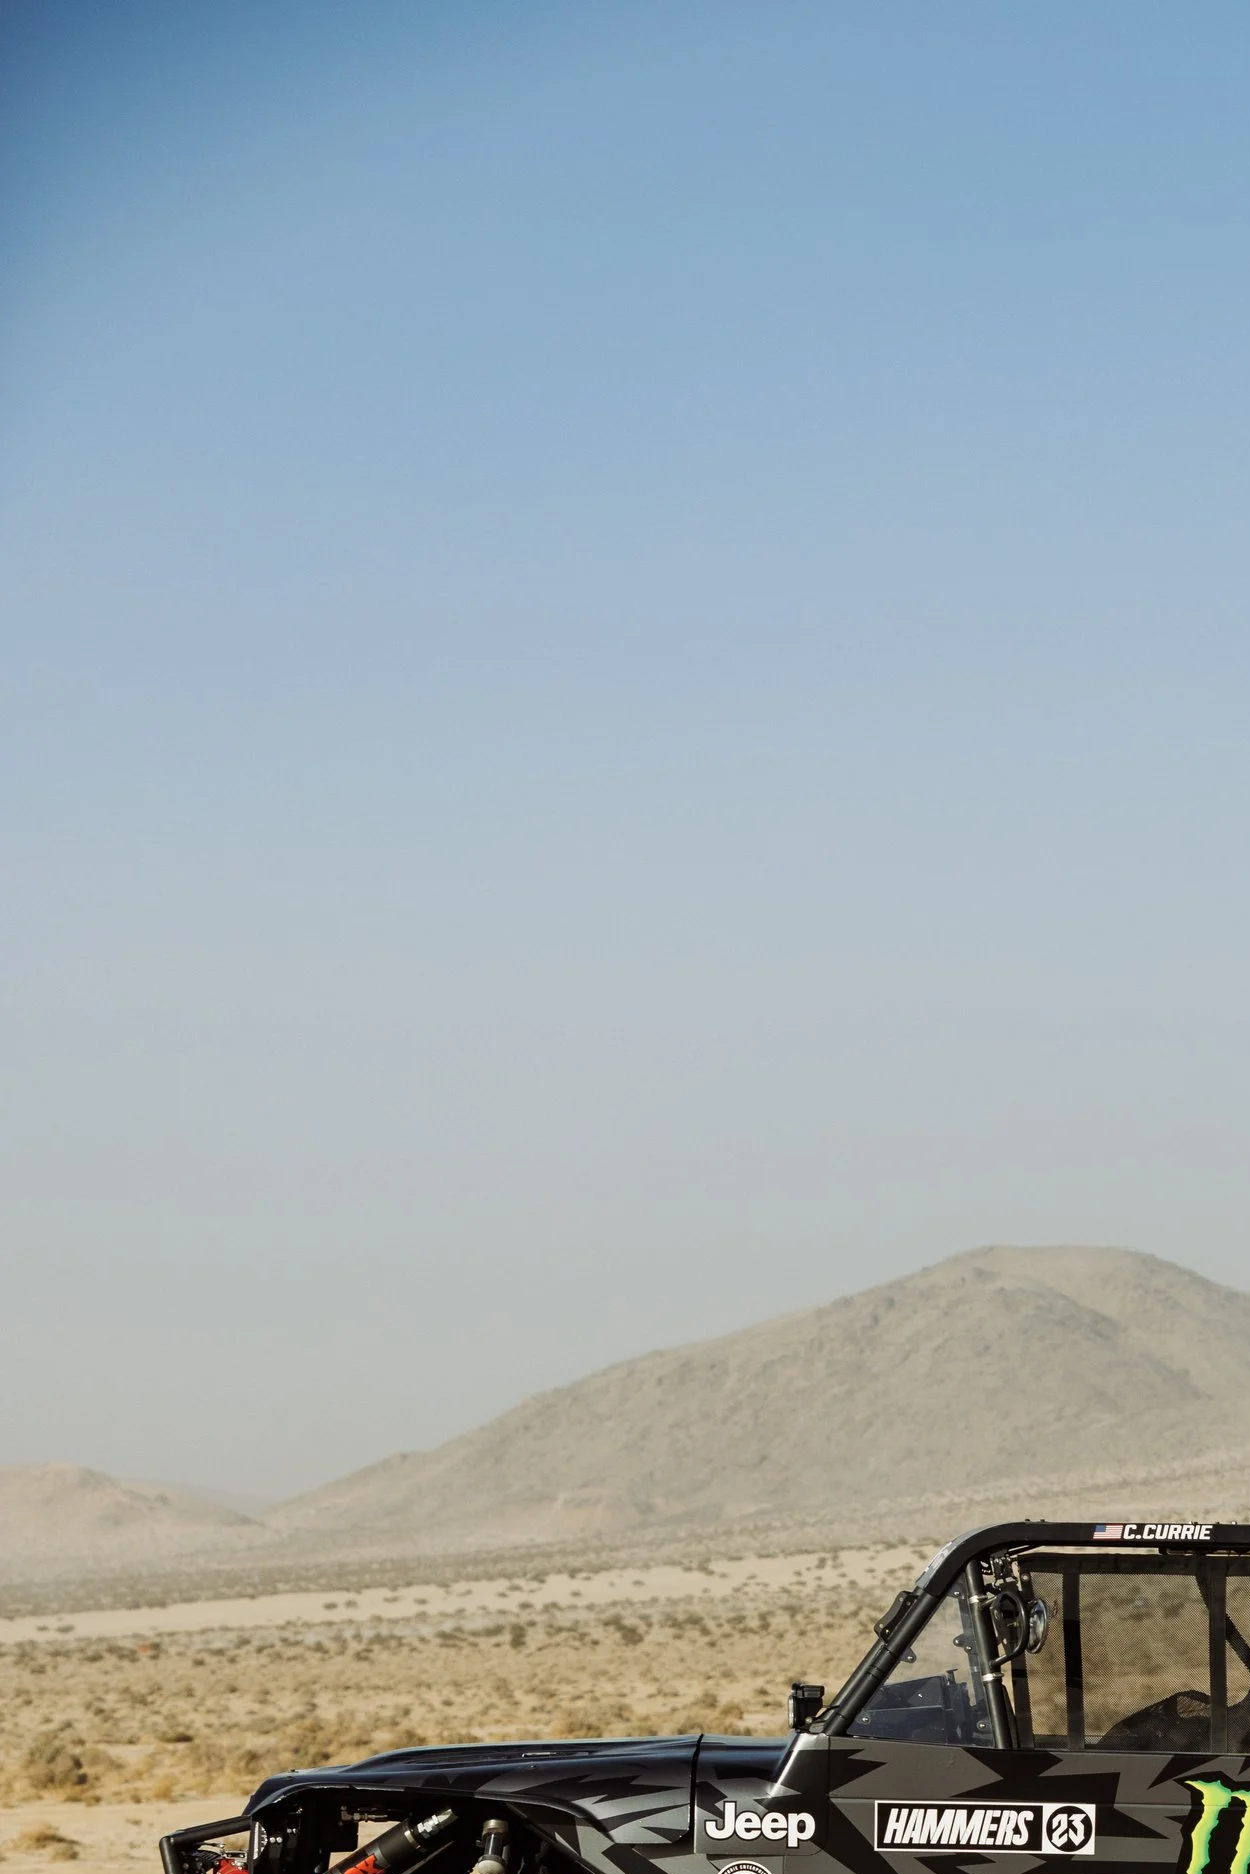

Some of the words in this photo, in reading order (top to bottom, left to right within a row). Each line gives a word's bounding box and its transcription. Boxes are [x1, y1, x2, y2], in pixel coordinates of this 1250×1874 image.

[1123, 1525, 1213, 1540] C.CURRIE
[705, 1801, 816, 1848] Jeep
[883, 1808, 1034, 1846] HAMMERS
[1052, 1813, 1087, 1848] 23
